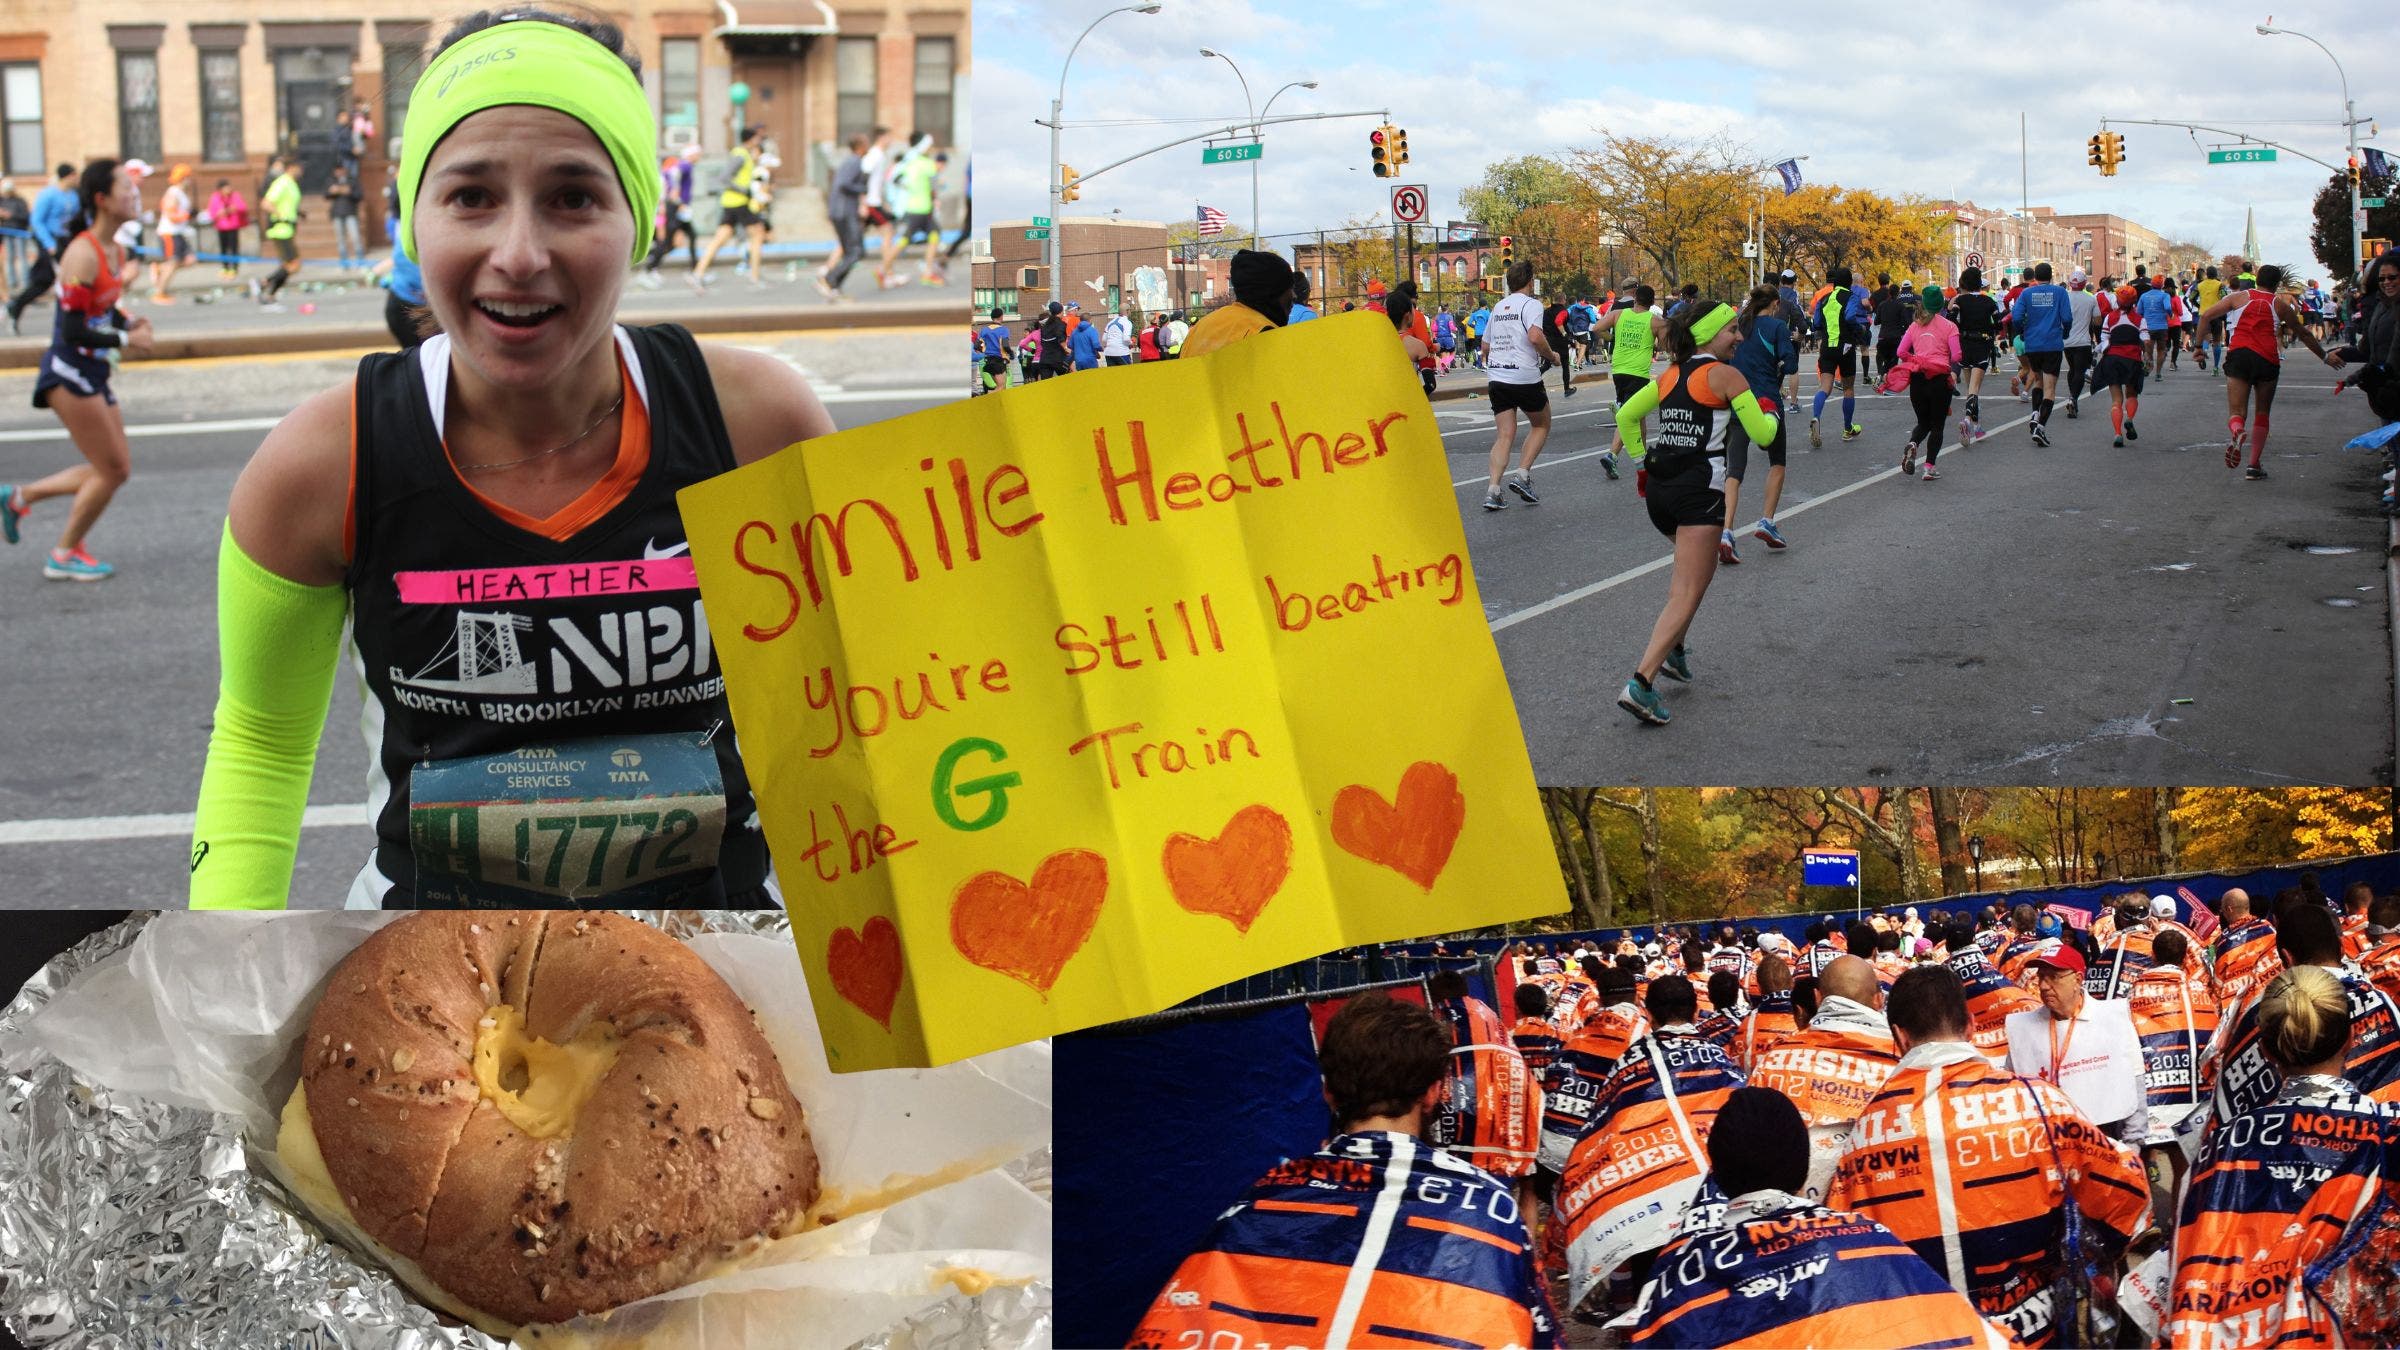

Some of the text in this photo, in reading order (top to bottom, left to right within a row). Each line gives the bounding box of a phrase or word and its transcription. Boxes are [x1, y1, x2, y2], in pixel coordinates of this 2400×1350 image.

[1217, 147, 1249, 161] 60 St
[2224, 151, 2261, 162] 60 St
[2363, 199, 2373, 208] 60
[1029, 230, 1038, 239] 60
[1662, 408, 1693, 421] NORTH
[734, 400, 1409, 642] Smile Heather
[458, 566, 649, 601] HEATHER
[1264, 552, 1465, 633] beating
[393, 686, 471, 717] NORTH
[481, 695, 623, 723] BROOKLYN
[487, 759, 587, 776] CONSULTANCY
[507, 774, 572, 789] SERVICES
[608, 771, 650, 783] TATA
[800, 722, 1260, 883] the G Train
[515, 808, 699, 888] 17772
[2363, 1030, 2379, 1043] ING
[1669, 1047, 1726, 1067] 2013
[2151, 1054, 2190, 1070] 2013
[1612, 1126, 1678, 1158] 2013
[1956, 1122, 2048, 1167] 2013
[2289, 1135, 2320, 1148] CITY
[1876, 1169, 1897, 1182] ING
[1900, 1167, 1922, 1179] THE
[1308, 1179, 1339, 1191] ING
[1596, 1211, 1646, 1241] UNITED
[1756, 1224, 1873, 1258] NEW YORK CITY
